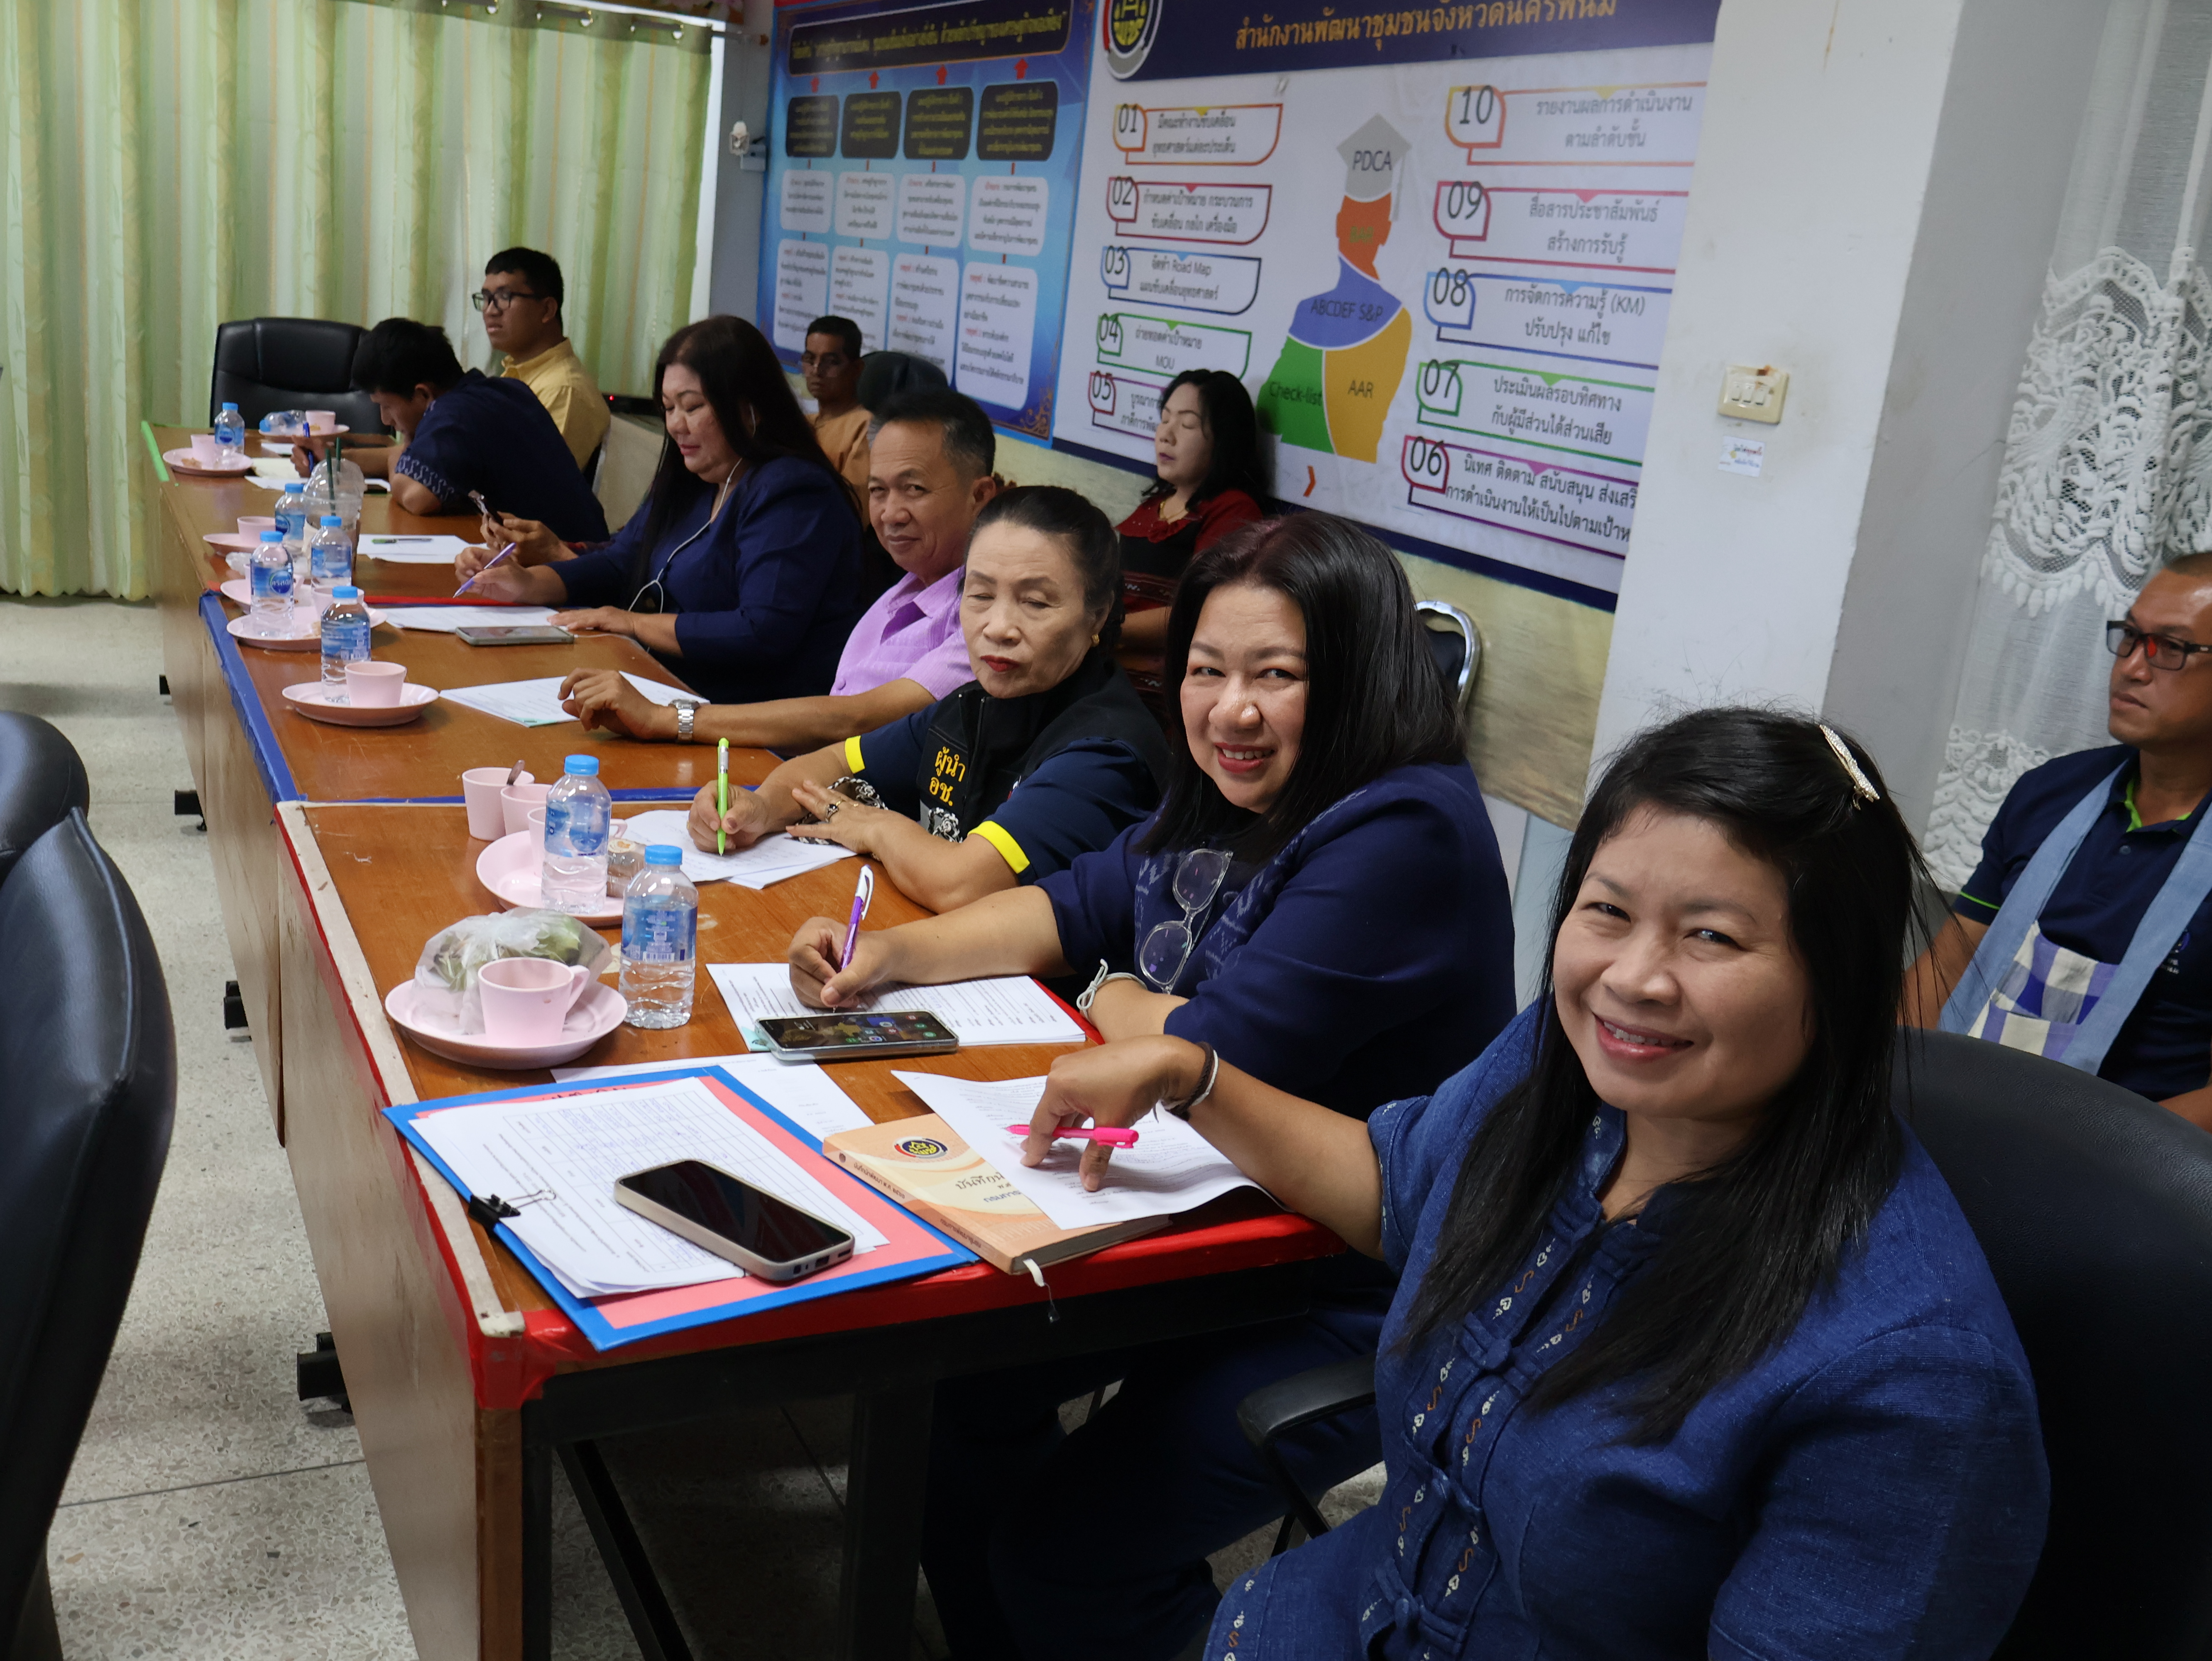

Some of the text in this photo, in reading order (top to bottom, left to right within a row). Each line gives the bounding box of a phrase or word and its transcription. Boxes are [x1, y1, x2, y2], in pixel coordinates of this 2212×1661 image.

[1235, 0, 1618, 51] สำนักงานพัฒนาชุมชนจงหวดนครพนม
[1118, 103, 1138, 133] 01
[1460, 86, 1495, 125] 10
[1536, 90, 1693, 115] รายงานผลการดำเนินงาน
[1565, 119, 1647, 147] ตามลำดับชั้น
[1352, 151, 1392, 171] PDCA
[1112, 176, 1134, 206] 02
[1447, 181, 1483, 220] 09
[1529, 192, 1660, 223] สื่อสารประชาสัมพันธ์
[1104, 245, 1126, 275] 03
[1546, 229, 1628, 263] สร้างการรับรู้
[1172, 260, 1192, 274] Road
[1194, 262, 1212, 276] Map
[1433, 268, 1468, 306] 08
[1505, 283, 1646, 318] การจัดการความรู้ (KM)
[1311, 299, 1383, 322] ABCDEF S&P
[1099, 313, 1119, 344] 04
[1525, 316, 1611, 347] ปรับปรุง แก้ไข
[1156, 354, 1175, 370] MOU
[1093, 370, 1112, 400] 05
[1269, 381, 1322, 406] Check-list
[1348, 379, 1373, 398] AAR
[1424, 359, 1459, 399] 07
[1494, 376, 1622, 412] ประเมินผลรอบทิศทาง
[1492, 404, 1613, 445] กับผู้มีส่วนได้ส่วนเสีย
[1411, 436, 1442, 476] 06
[1464, 453, 1492, 476] นิเทศ
[1496, 460, 1535, 486] ติดตาม
[1539, 470, 1595, 503] สนับสนุน
[935, 746, 966, 782] ผู้นำ
[929, 777, 954, 806] อช.
